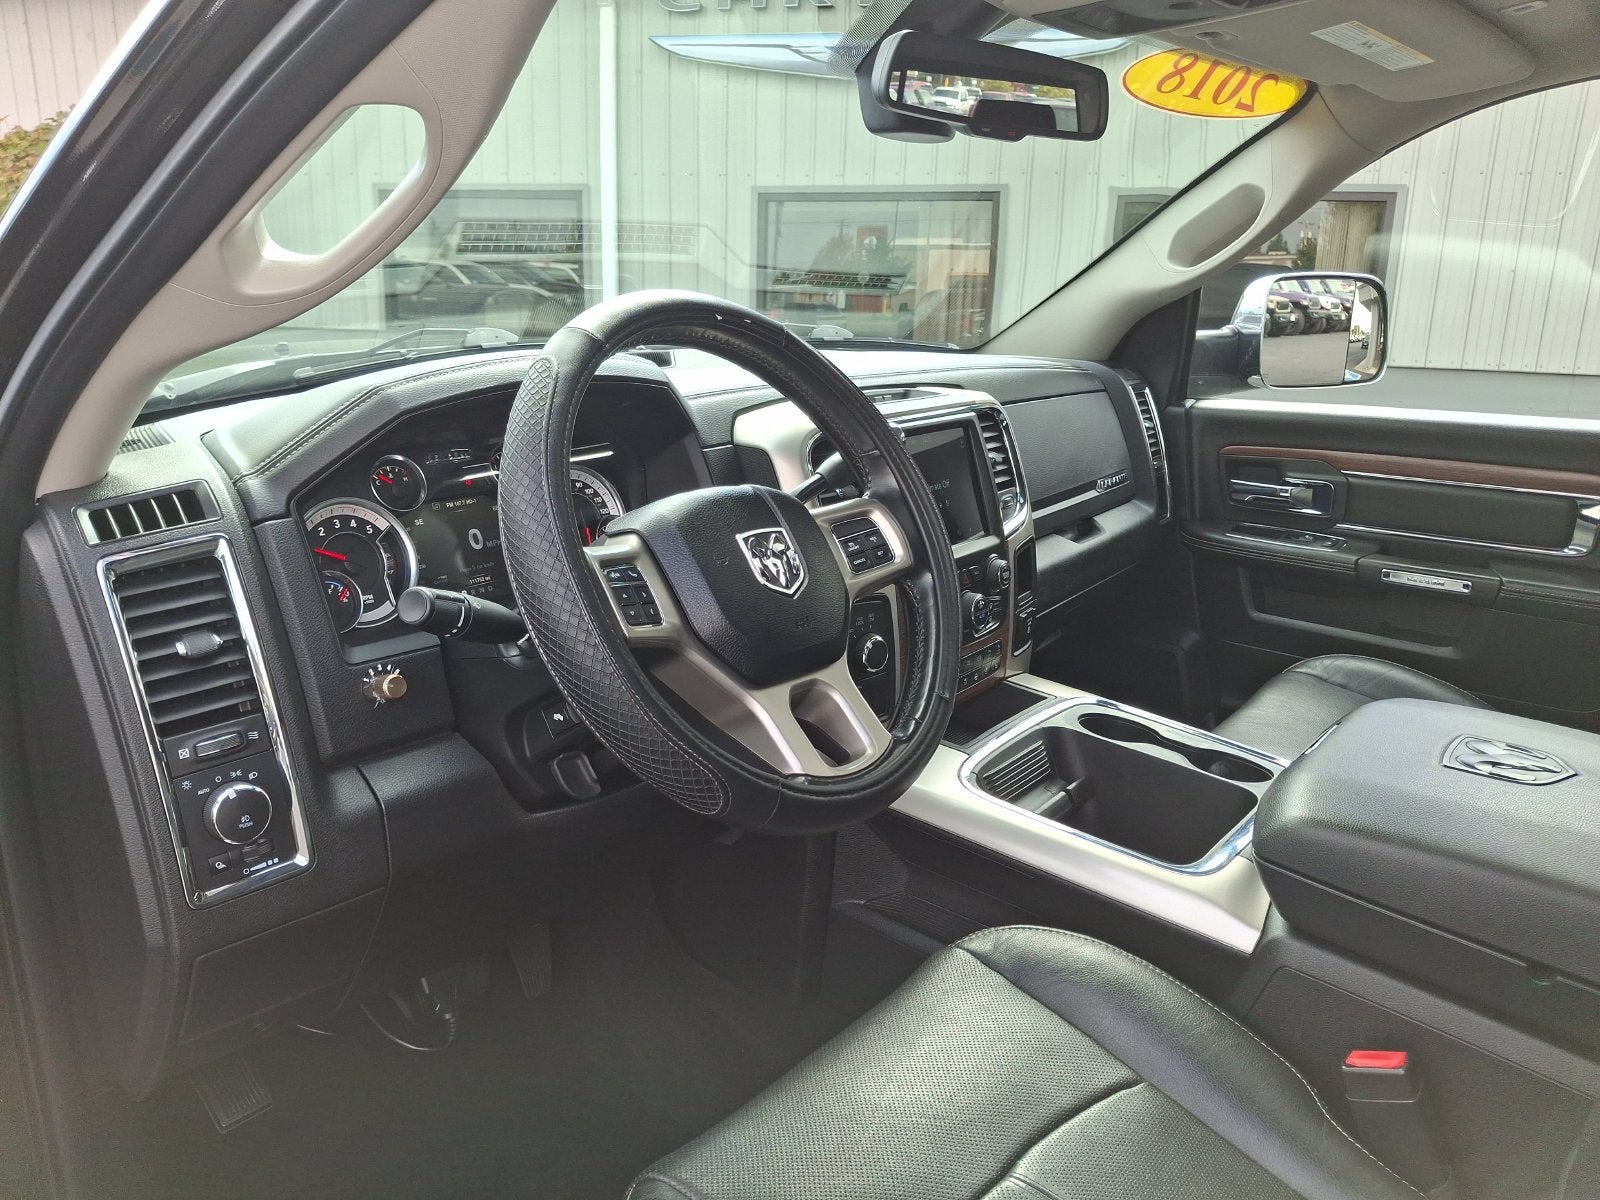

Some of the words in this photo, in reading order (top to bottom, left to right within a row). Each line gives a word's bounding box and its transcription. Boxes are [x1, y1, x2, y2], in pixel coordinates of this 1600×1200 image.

[333, 519, 341, 529] 3
[350, 519, 357, 528] 4
[317, 527, 326, 537] 2
[366, 524, 373, 534] 5
